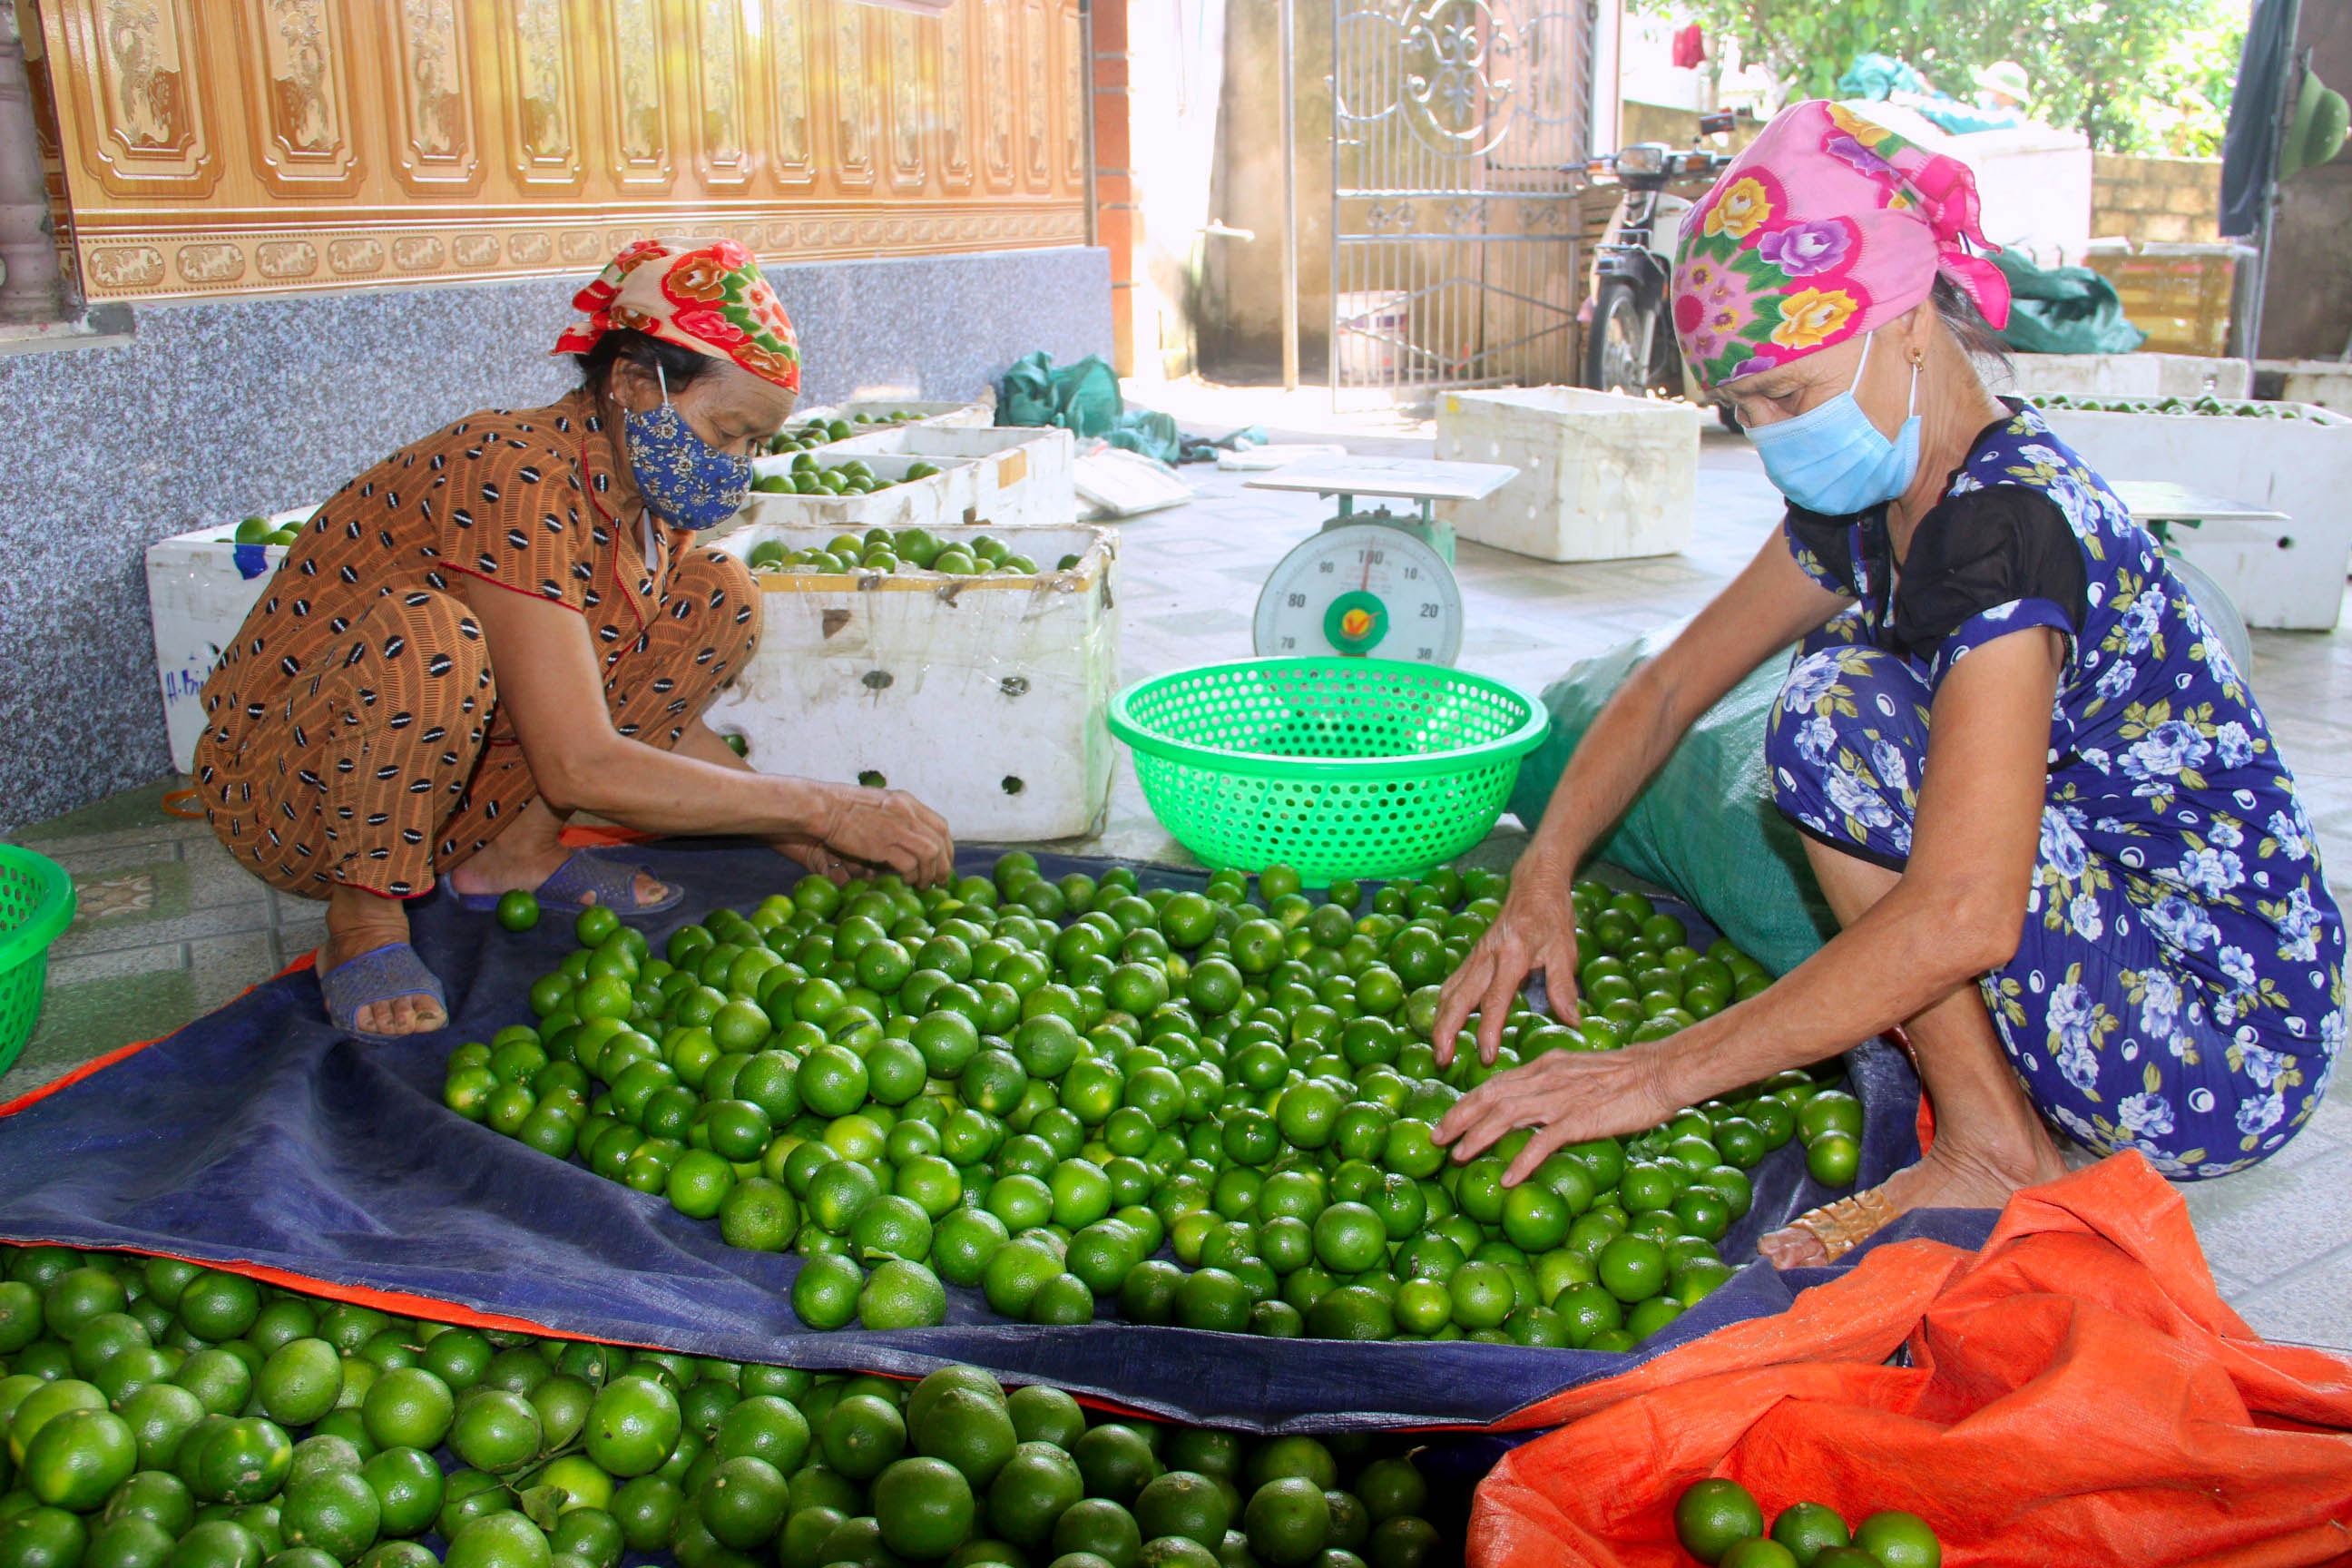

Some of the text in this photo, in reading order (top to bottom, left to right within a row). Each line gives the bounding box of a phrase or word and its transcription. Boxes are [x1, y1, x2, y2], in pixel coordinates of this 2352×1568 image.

[1357, 549, 1384, 565] 100
[1319, 561, 1334, 573] 90
[1404, 567, 1418, 581] 10
[1288, 593, 1307, 609] 80
[1420, 603, 1439, 618] 20
[1280, 636, 1296, 650] 70
[1416, 647, 1432, 660] 30
